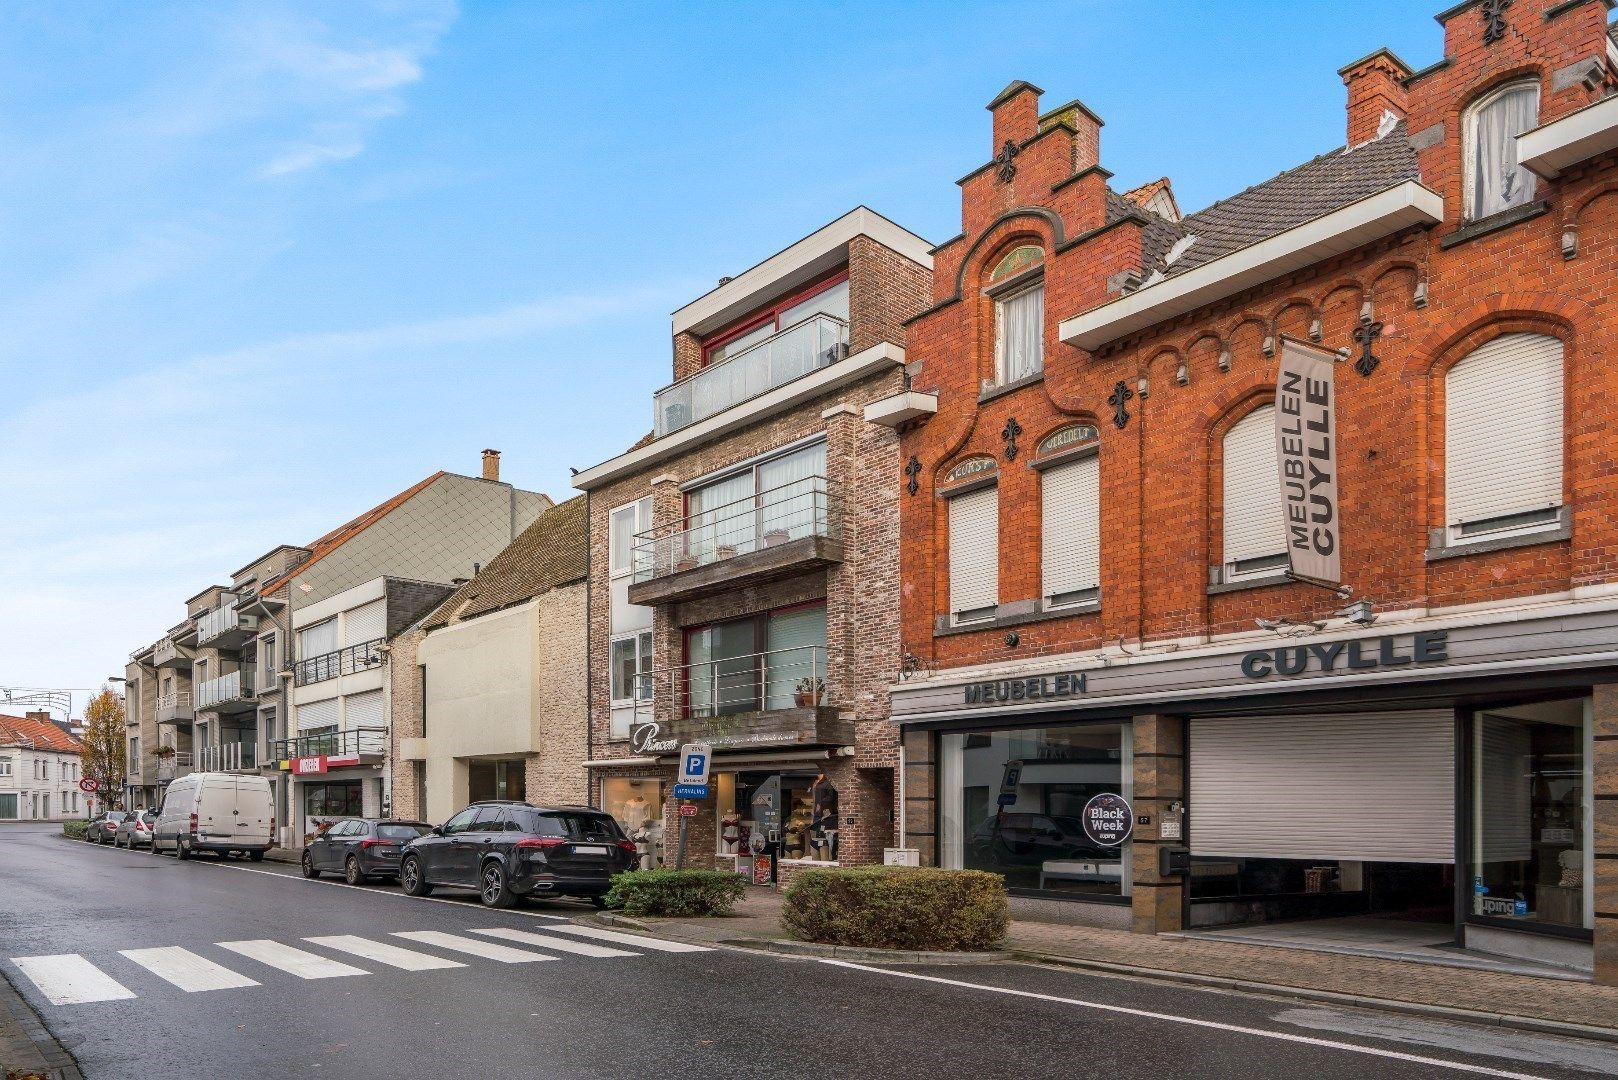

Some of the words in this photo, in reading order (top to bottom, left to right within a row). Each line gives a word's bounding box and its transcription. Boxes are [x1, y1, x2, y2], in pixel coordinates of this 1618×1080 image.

[1281, 371, 1310, 551] MEUBELEN
[1306, 377, 1334, 556] CUYLLE
[1241, 631, 1448, 679] CUYLLE
[965, 673, 1086, 704] MEUBELEN
[634, 722, 678, 753] Princess
[690, 757, 702, 772] P
[1090, 807, 1125, 819] Black
[1090, 819, 1124, 831] Week
[1475, 900, 1514, 916] uping
